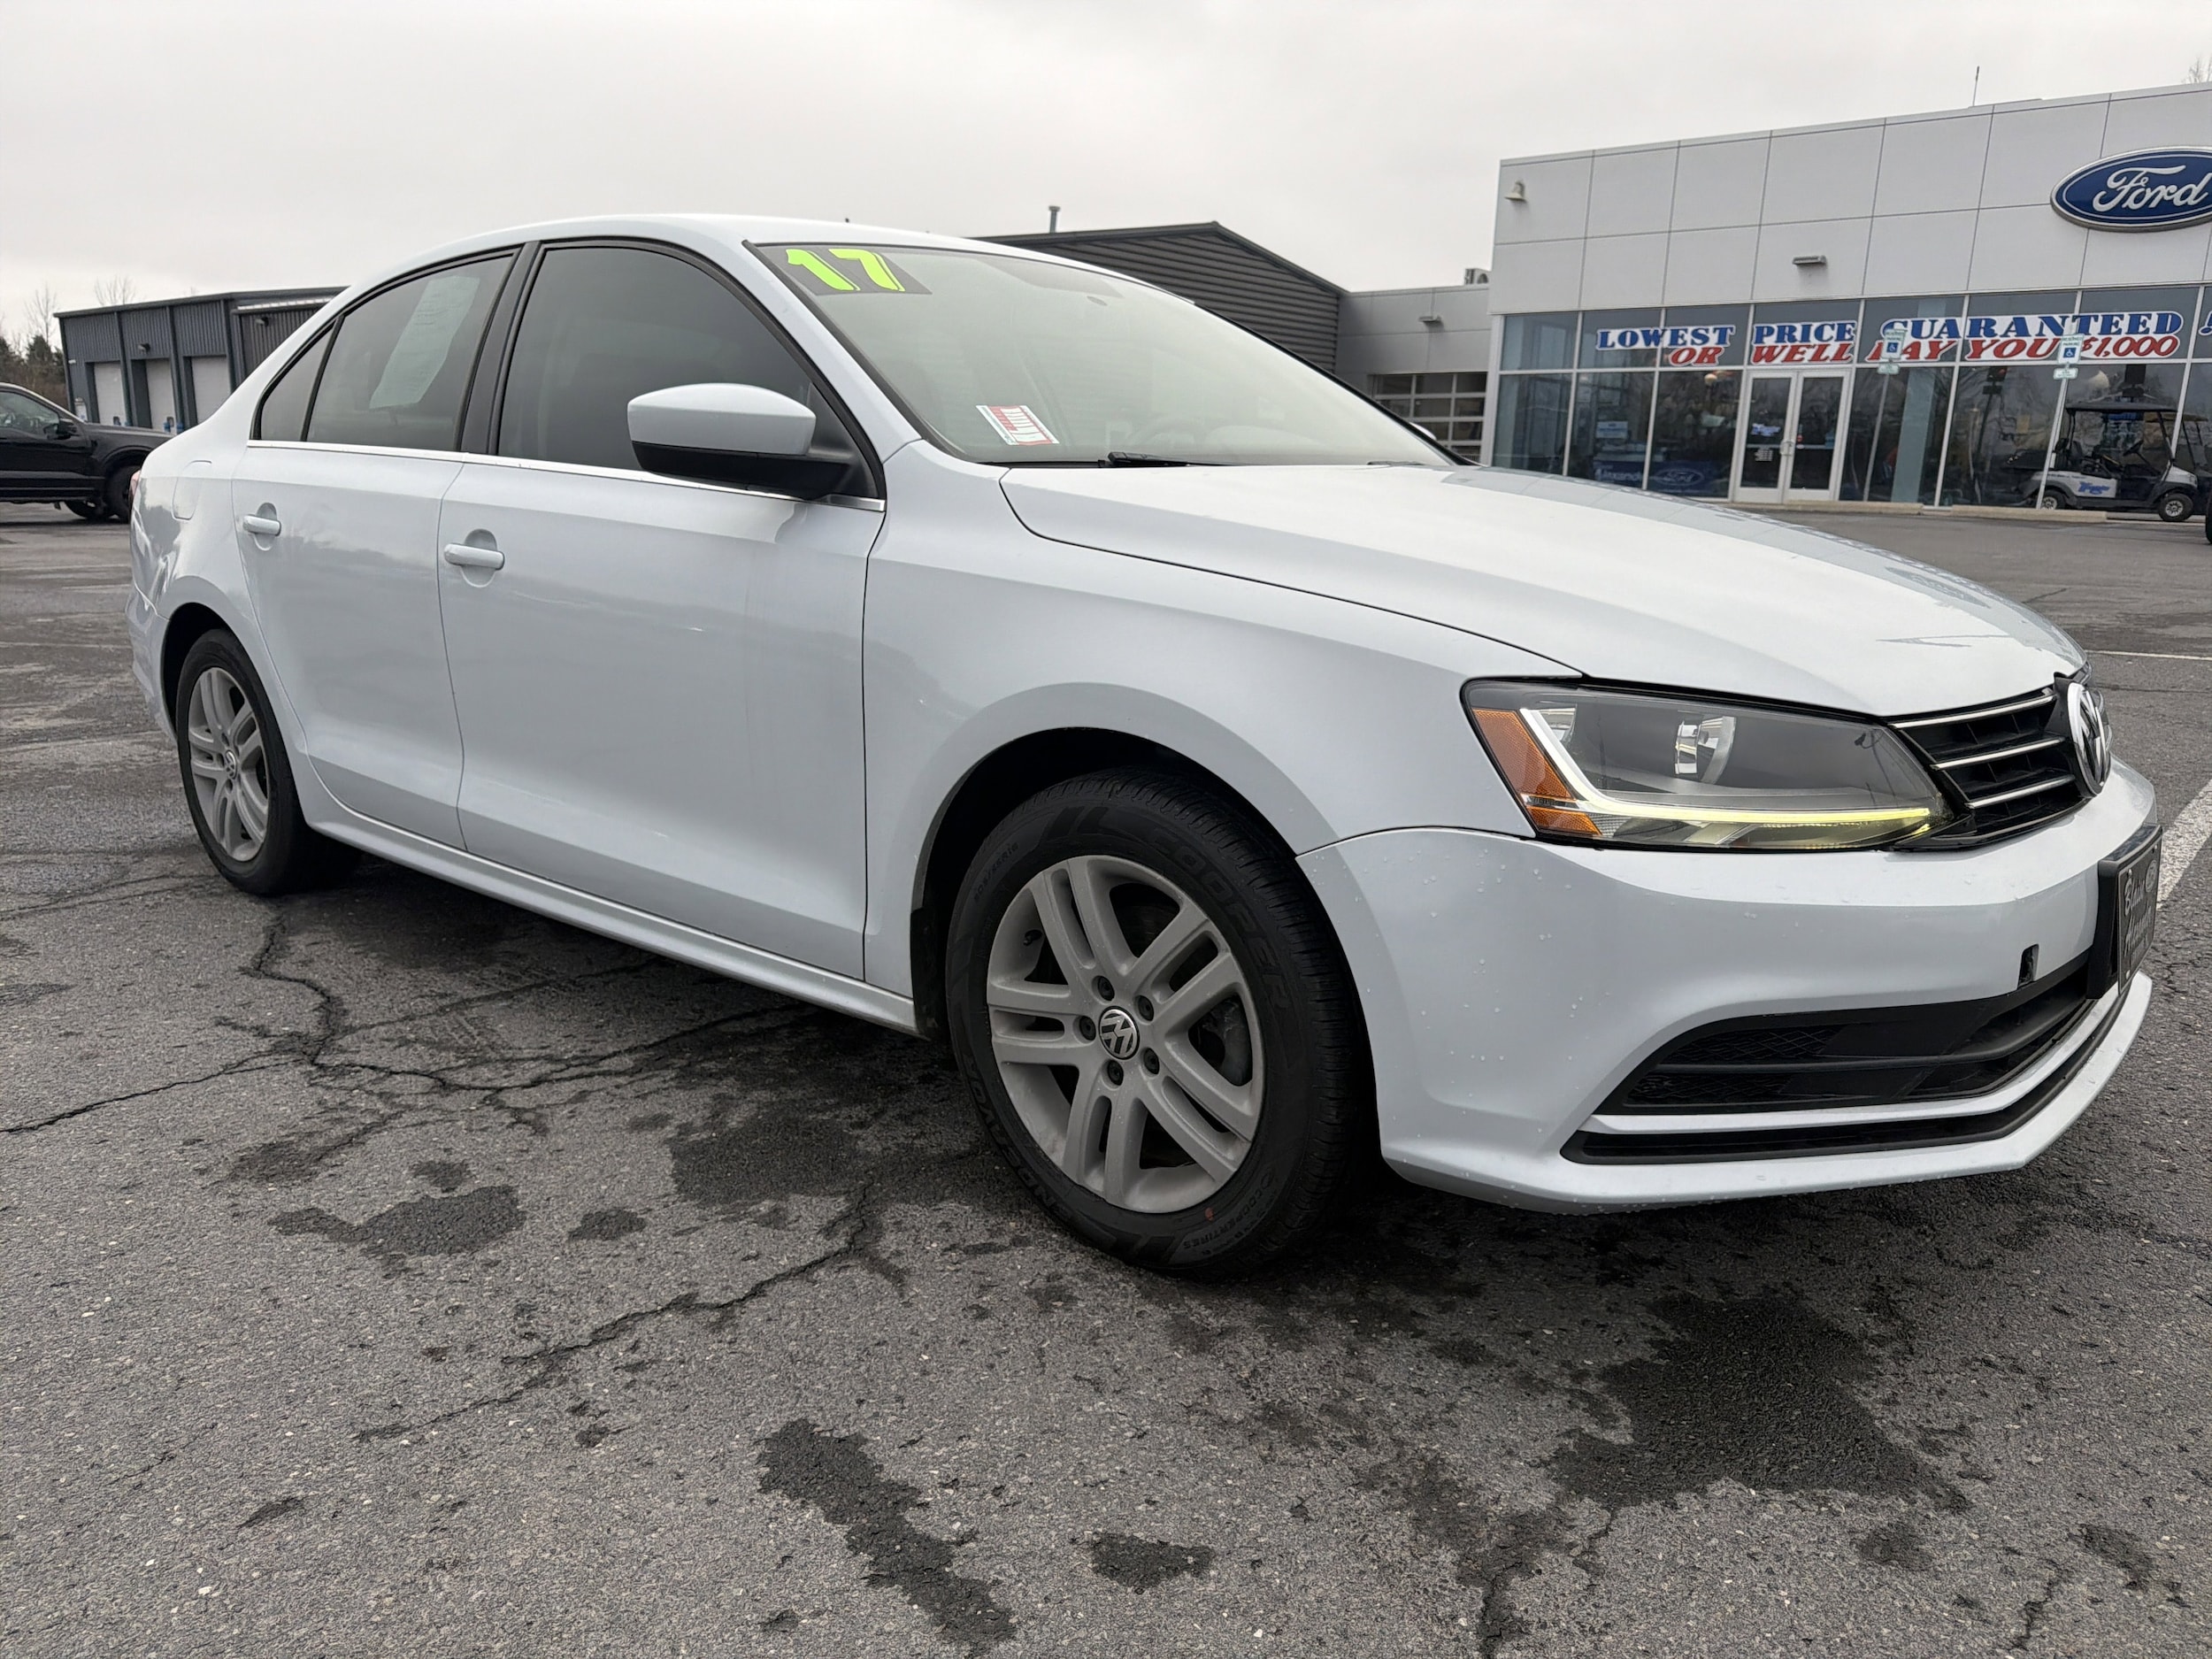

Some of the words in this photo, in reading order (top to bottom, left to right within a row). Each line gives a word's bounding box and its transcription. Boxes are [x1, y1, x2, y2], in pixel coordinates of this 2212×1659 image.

[2092, 165, 2212, 212] Ford
[786, 249, 905, 291] 17
[1598, 326, 1735, 349] LOWEST
[1754, 321, 1856, 344] PRICE
[1670, 346, 1724, 365] OR
[1752, 342, 1853, 364] WE'LL
[1966, 337, 2062, 359] YOU
[2081, 335, 2178, 357] $1,000
